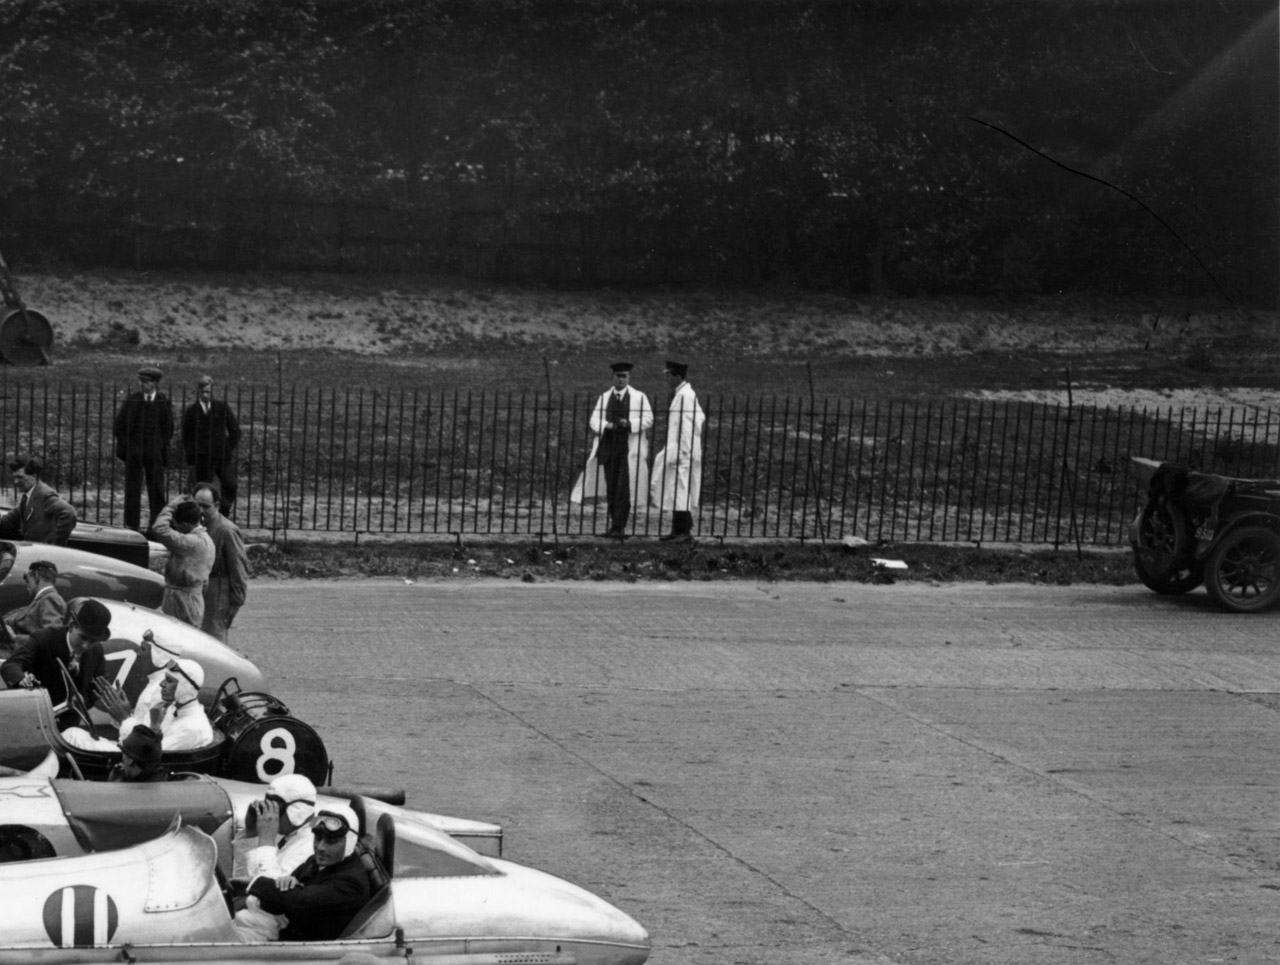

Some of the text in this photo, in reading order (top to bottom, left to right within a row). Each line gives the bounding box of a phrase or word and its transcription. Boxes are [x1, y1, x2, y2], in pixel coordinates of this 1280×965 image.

[104, 649, 138, 690] 7
[256, 727, 297, 784] 8
[61, 886, 108, 948] 11
